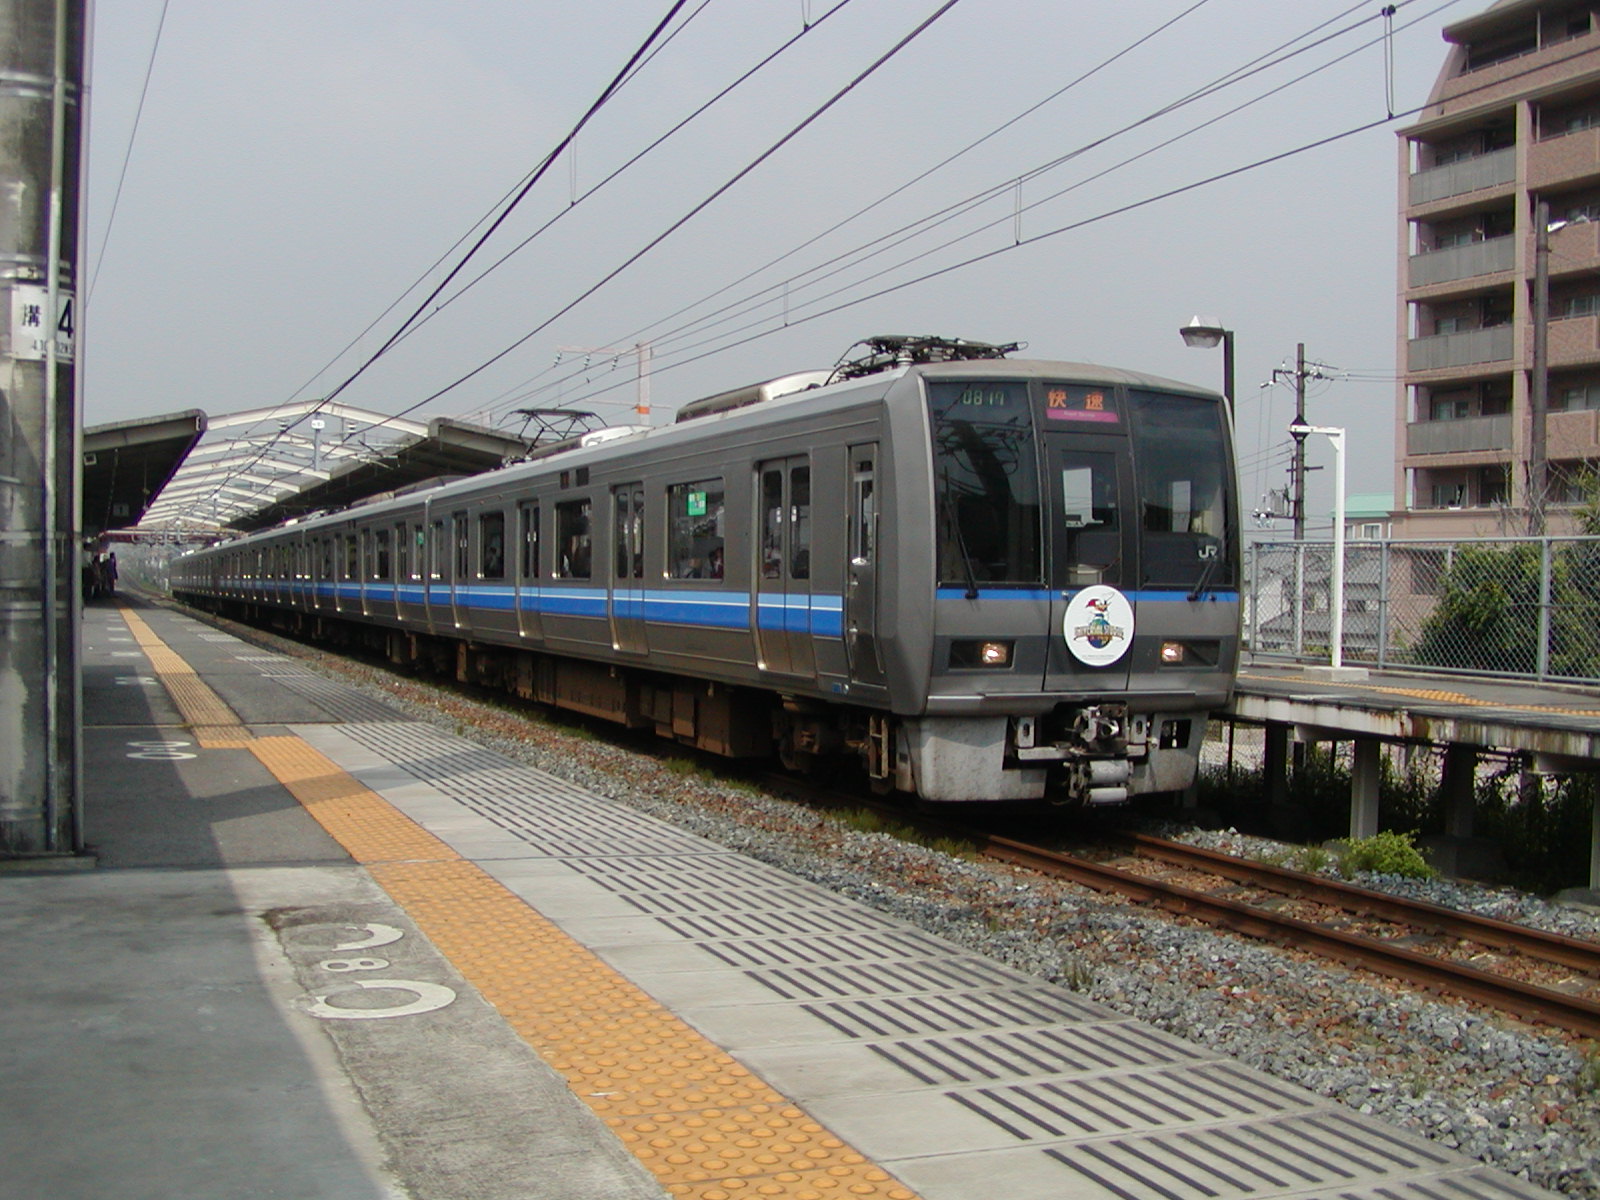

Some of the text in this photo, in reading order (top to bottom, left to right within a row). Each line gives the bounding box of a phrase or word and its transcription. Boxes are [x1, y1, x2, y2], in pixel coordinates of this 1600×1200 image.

[58, 298, 74, 339] 4
[1048, 388, 1105, 411] 快速
[1198, 545, 1218, 560] JR
